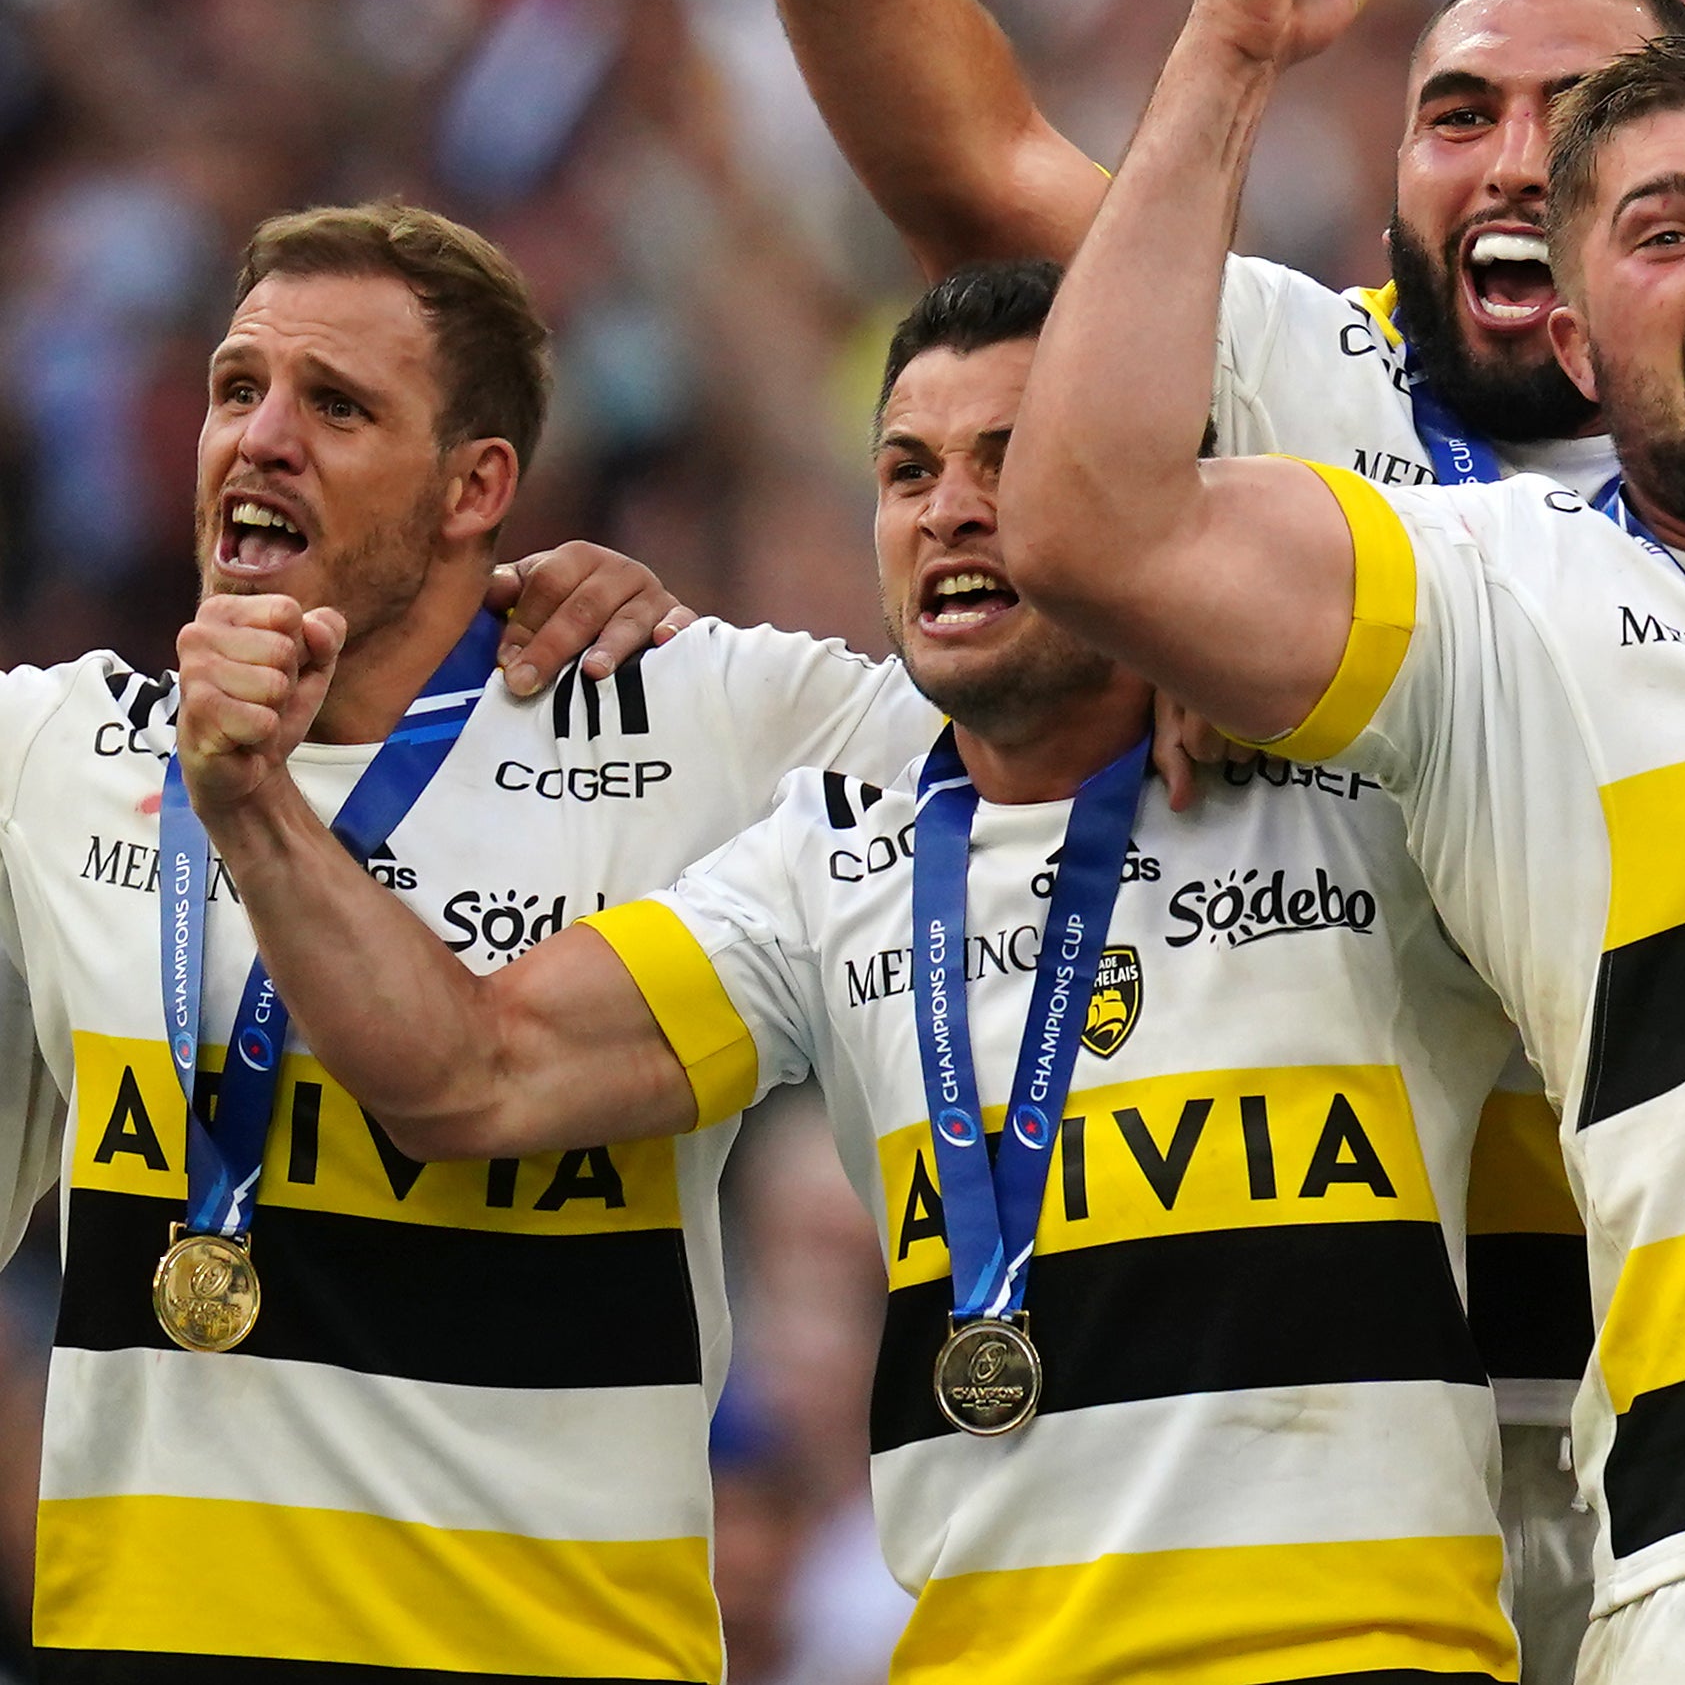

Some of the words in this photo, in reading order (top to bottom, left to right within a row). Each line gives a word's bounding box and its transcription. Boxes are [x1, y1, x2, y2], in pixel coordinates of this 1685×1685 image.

[495, 760, 673, 802] COGEP
[175, 851, 191, 896] CUP
[174, 897, 191, 1028] CHAMPIONS
[929, 919, 948, 966] CUP
[1029, 961, 1075, 1103] CHAMPIONS
[1059, 913, 1086, 962] CUP
[929, 967, 960, 1104] CHAMPIONS
[897, 1092, 1398, 1262] AIVIA
